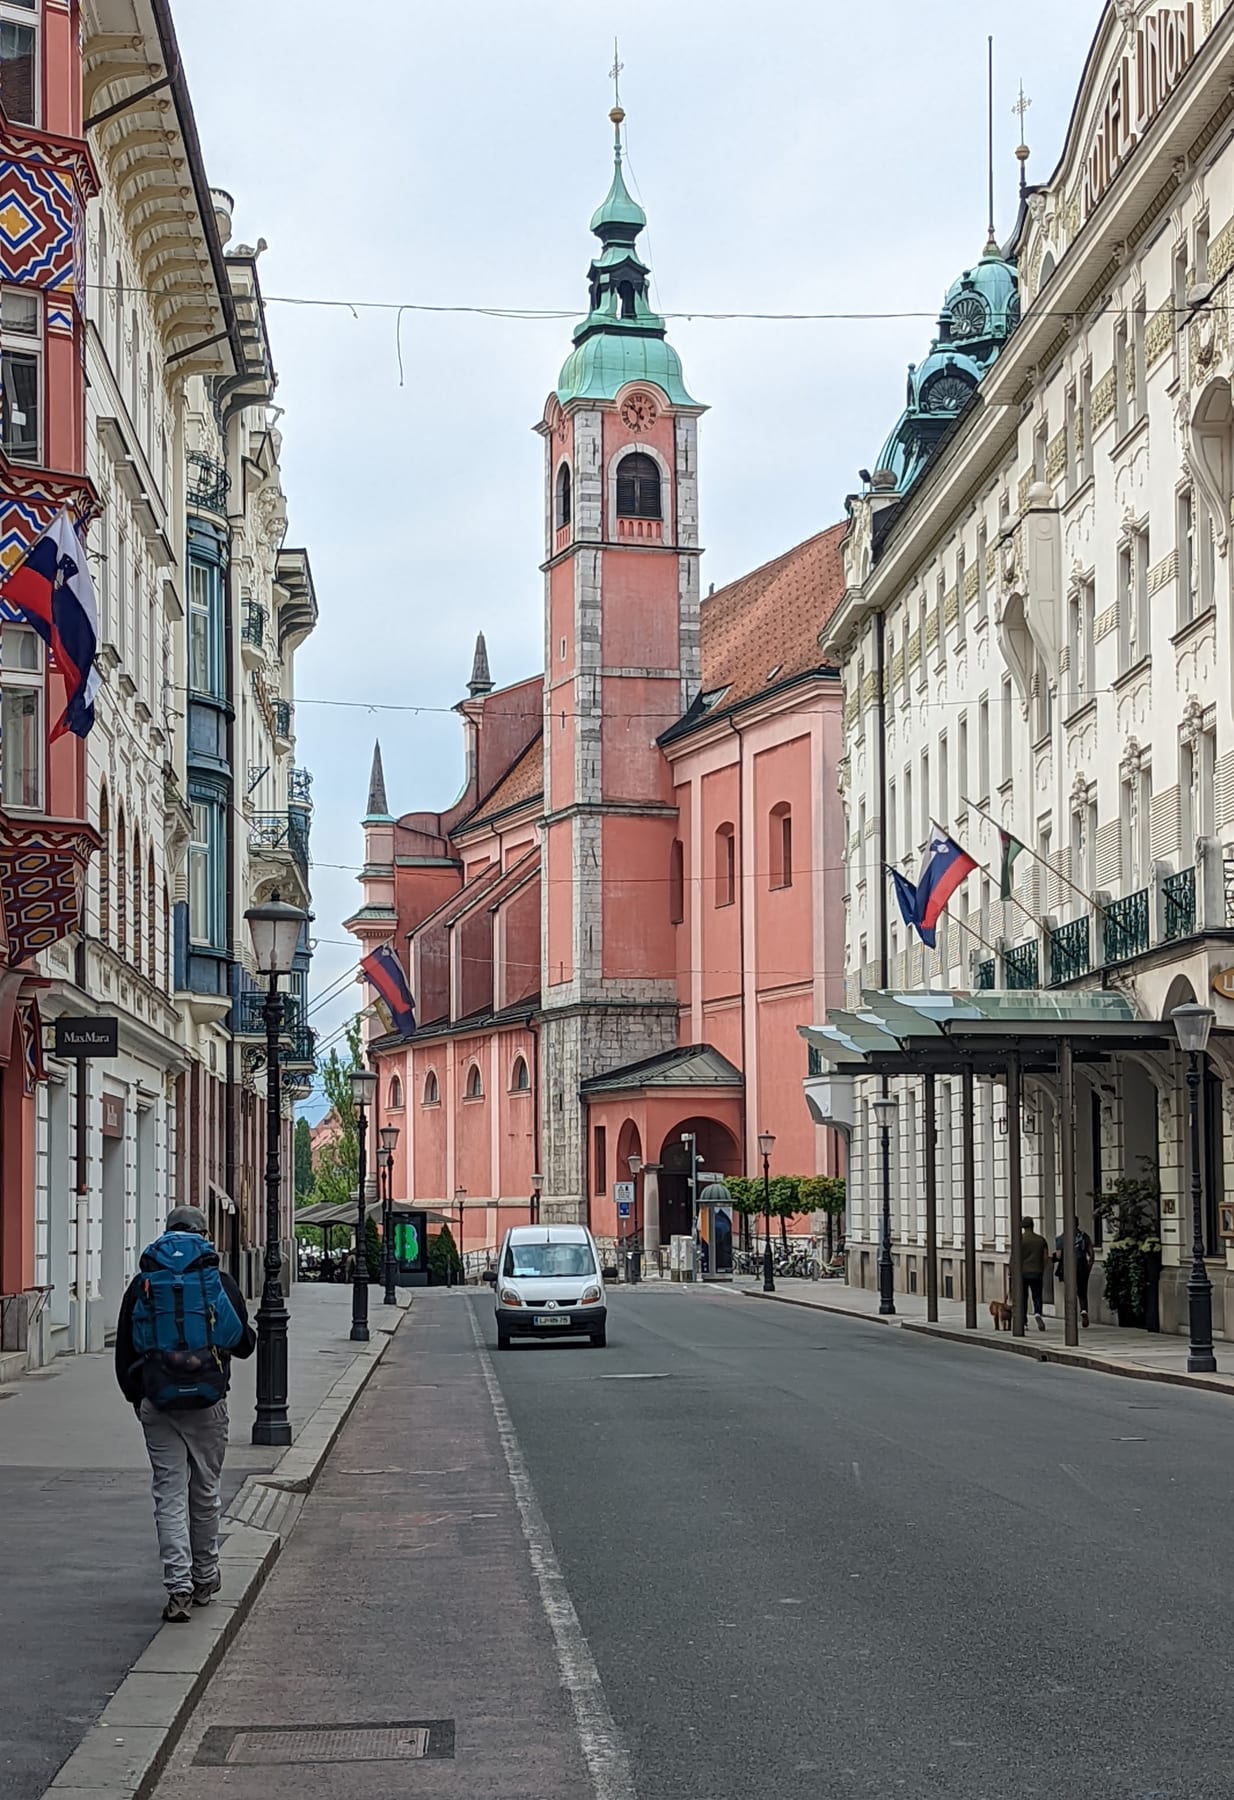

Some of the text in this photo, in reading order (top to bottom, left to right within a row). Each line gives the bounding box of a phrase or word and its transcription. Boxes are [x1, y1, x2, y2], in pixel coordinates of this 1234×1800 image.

[1082, 2, 1194, 219] HOTEL UNION
[64, 1032, 110, 1043] MaxMara
